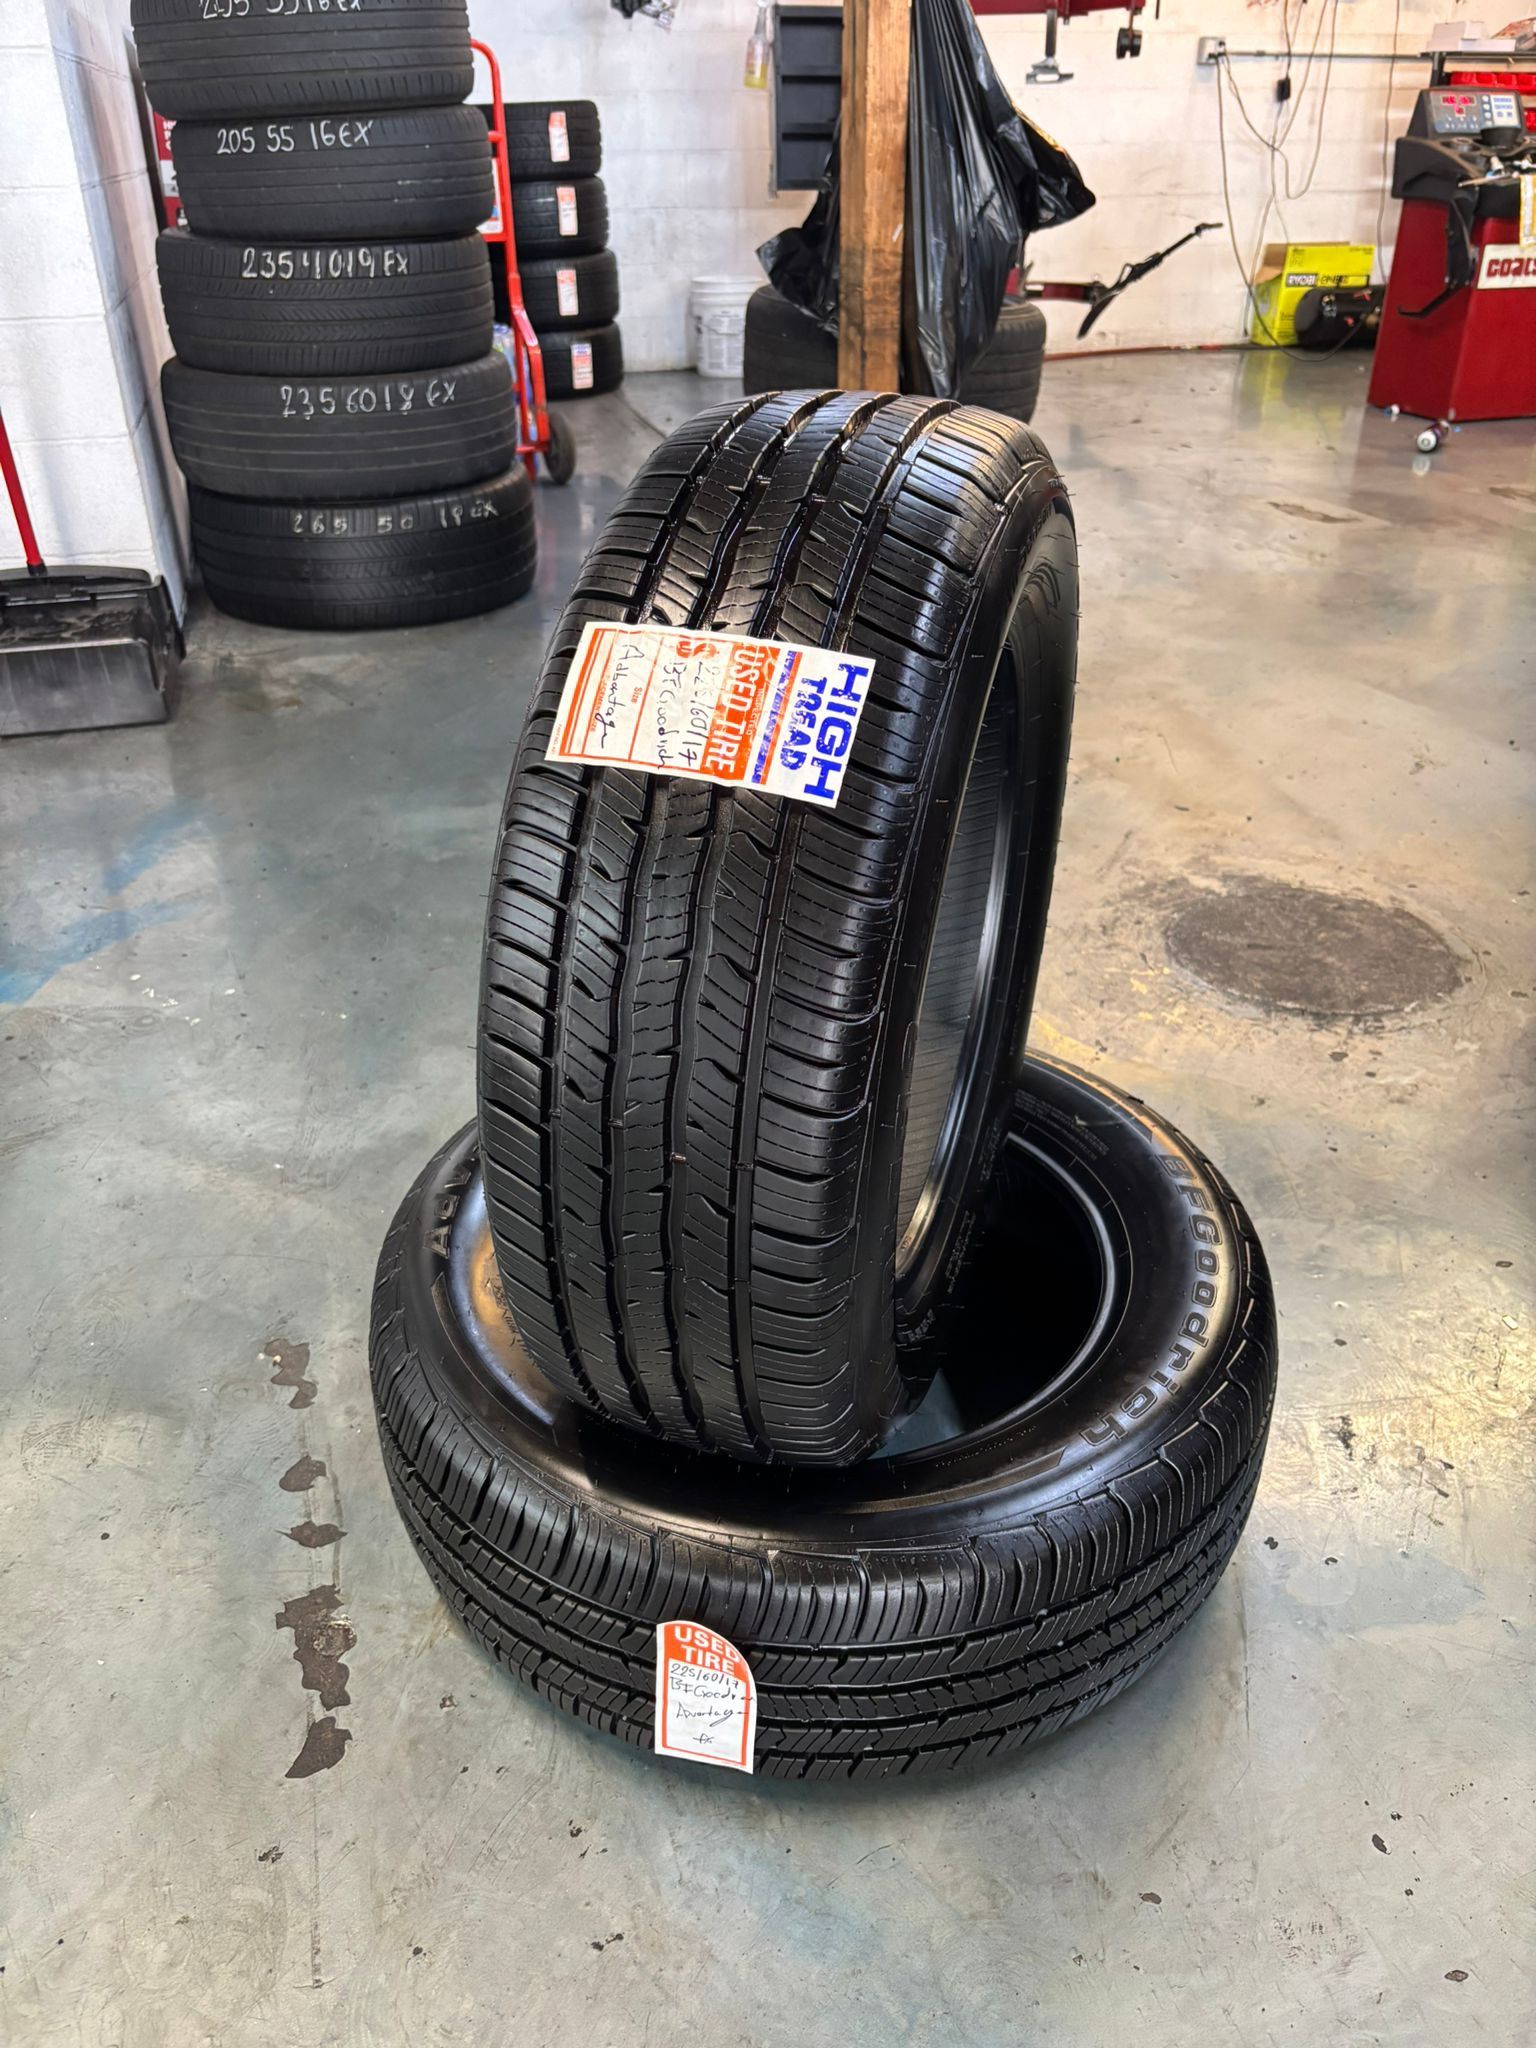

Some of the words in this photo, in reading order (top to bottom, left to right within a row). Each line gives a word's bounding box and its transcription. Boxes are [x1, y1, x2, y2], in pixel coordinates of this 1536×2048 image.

[217, 128, 255, 154] 205
[267, 125, 295, 152] 55
[242, 247, 294, 279] 235
[281, 385, 336, 420] 235
[293, 513, 347, 535] 265
[377, 515, 414, 533] 50
[629, 685, 643, 704] Size
[719, 647, 765, 712] USED
[780, 676, 827, 771] TREAD
[804, 662, 869, 800] HIGH
[702, 718, 747, 773] TIRE
[1079, 1153, 1222, 1447] BFGoodrich
[674, 1625, 741, 1664] USED
[681, 1645, 735, 1675] TIRE
